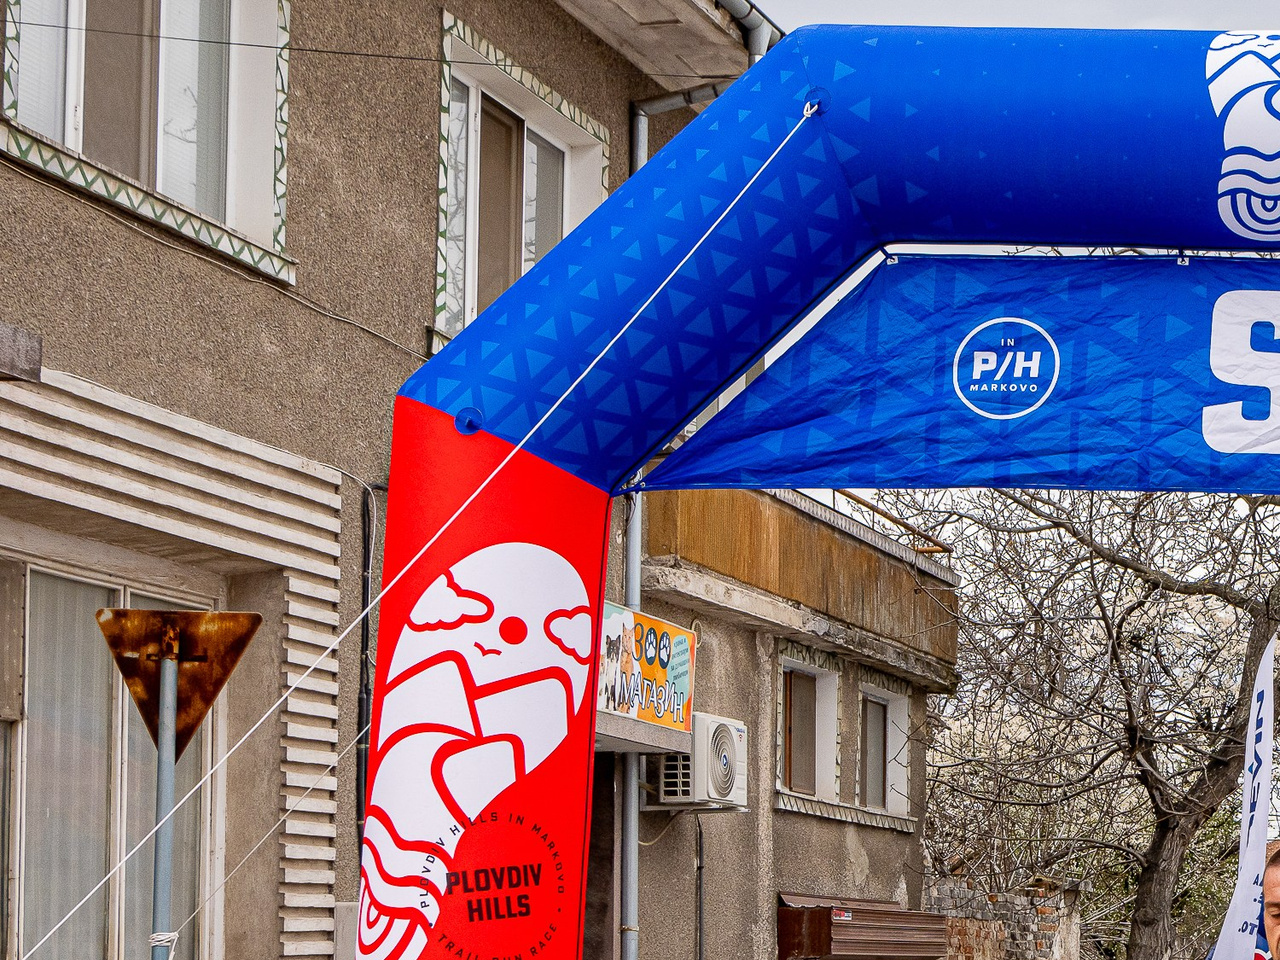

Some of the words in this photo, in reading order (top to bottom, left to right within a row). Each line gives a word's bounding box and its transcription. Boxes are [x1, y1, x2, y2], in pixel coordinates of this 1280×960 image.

[1001, 338, 1015, 346] IN
[972, 351, 1041, 381] P/H
[969, 383, 1038, 392] MARKOVO
[620, 671, 684, 722] МАГАЗИН
[420, 838, 447, 908] PLOVDIV
[449, 811, 499, 836] HILLS
[508, 812, 525, 827] IN
[531, 823, 566, 894] MARKOVO
[446, 863, 542, 895] PLOVDIV
[467, 894, 531, 922] HILLS
[530, 923, 557, 956] RACE
